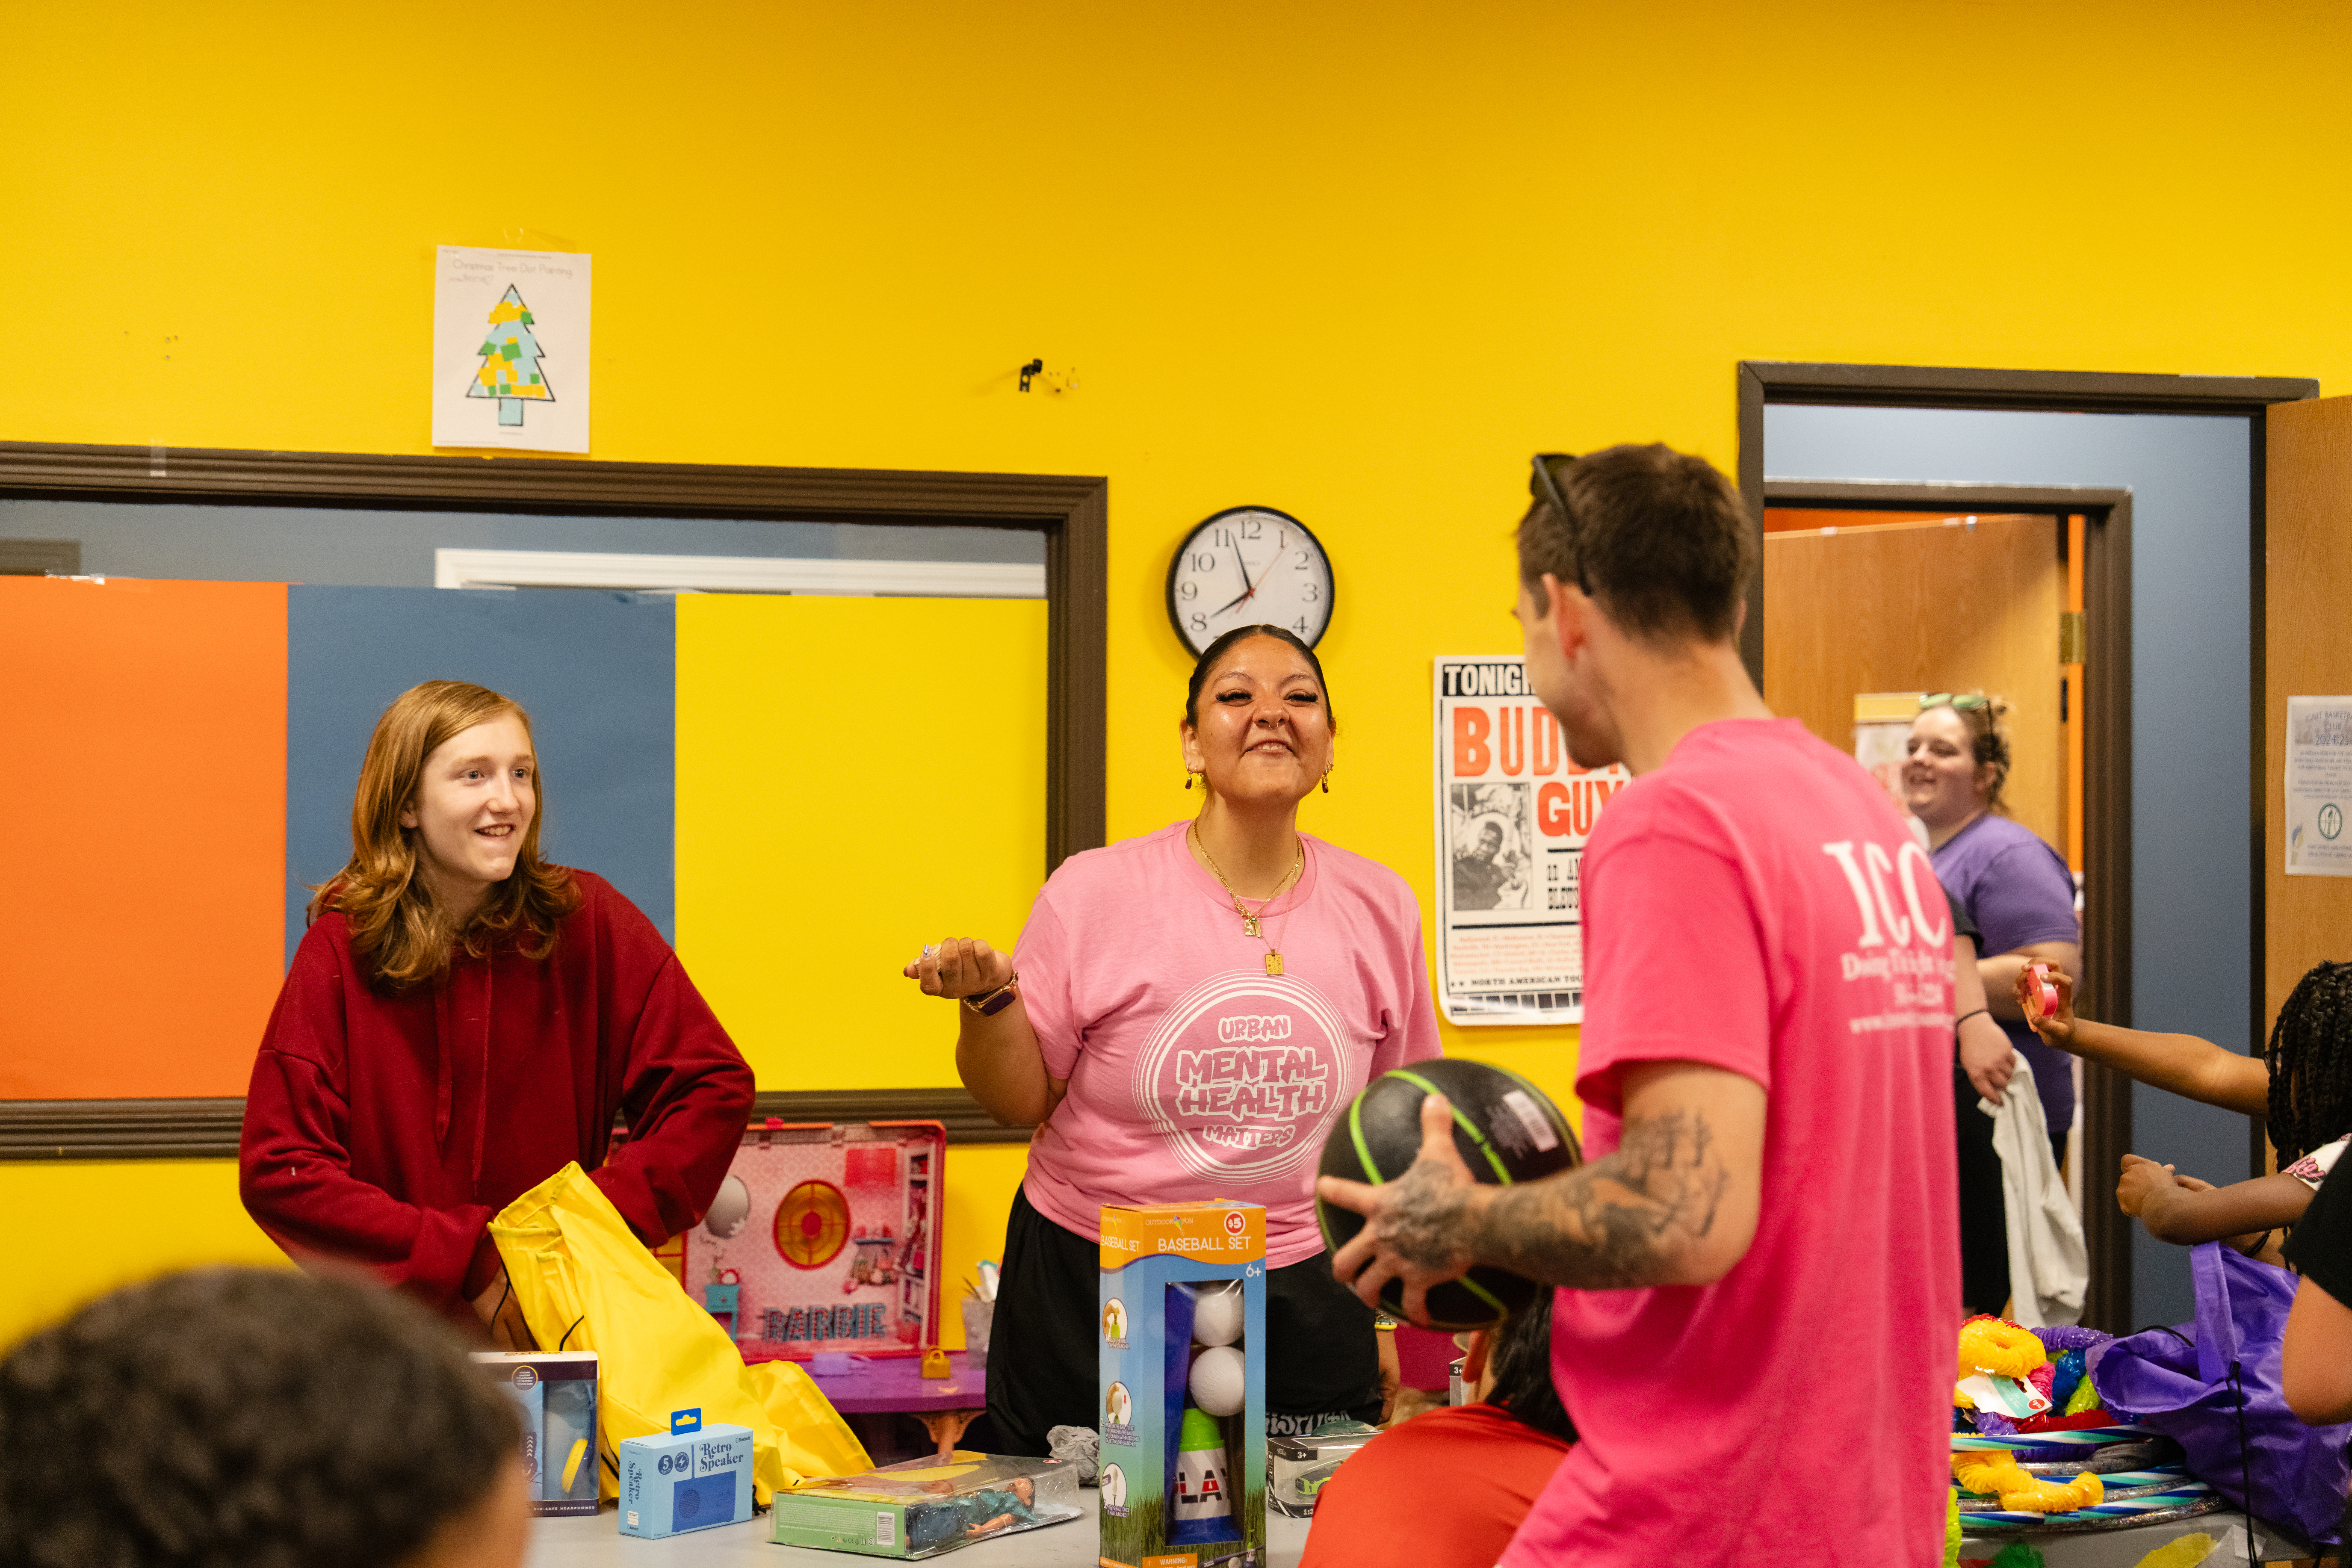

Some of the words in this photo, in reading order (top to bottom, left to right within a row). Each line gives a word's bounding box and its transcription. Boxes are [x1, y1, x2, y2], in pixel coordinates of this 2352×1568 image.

[1215, 529, 1230, 547] 11
[1241, 520, 1262, 539] 12
[1279, 530, 1285, 549] 1
[1191, 552, 1215, 572] 10
[1294, 551, 1309, 570] 2
[1181, 582, 1198, 601] 9
[1302, 583, 1318, 602] 3
[1191, 612, 1208, 632] 8
[1293, 615, 1308, 633] 4
[1510, 976, 1560, 984] AMERICAN
[1219, 1015, 1291, 1042] URBAN
[1176, 1046, 1328, 1086] MENTAL
[1176, 1082, 1326, 1121] HEALTH
[1203, 1125, 1295, 1150] MATTERS
[1228, 1217, 1242, 1229] $5
[1101, 1234, 1129, 1250] BASEBALL
[1129, 1240, 1140, 1252] SET
[1158, 1237, 1224, 1252] BASEBALL
[1228, 1236, 1251, 1250] SET
[1246, 1263, 1262, 1277] 6+
[699, 1443, 732, 1459] Retro
[663, 1457, 669, 1470] 5
[700, 1453, 744, 1472] Speaker
[628, 1461, 636, 1505] Speaker
[633, 1469, 642, 1500] Retro
